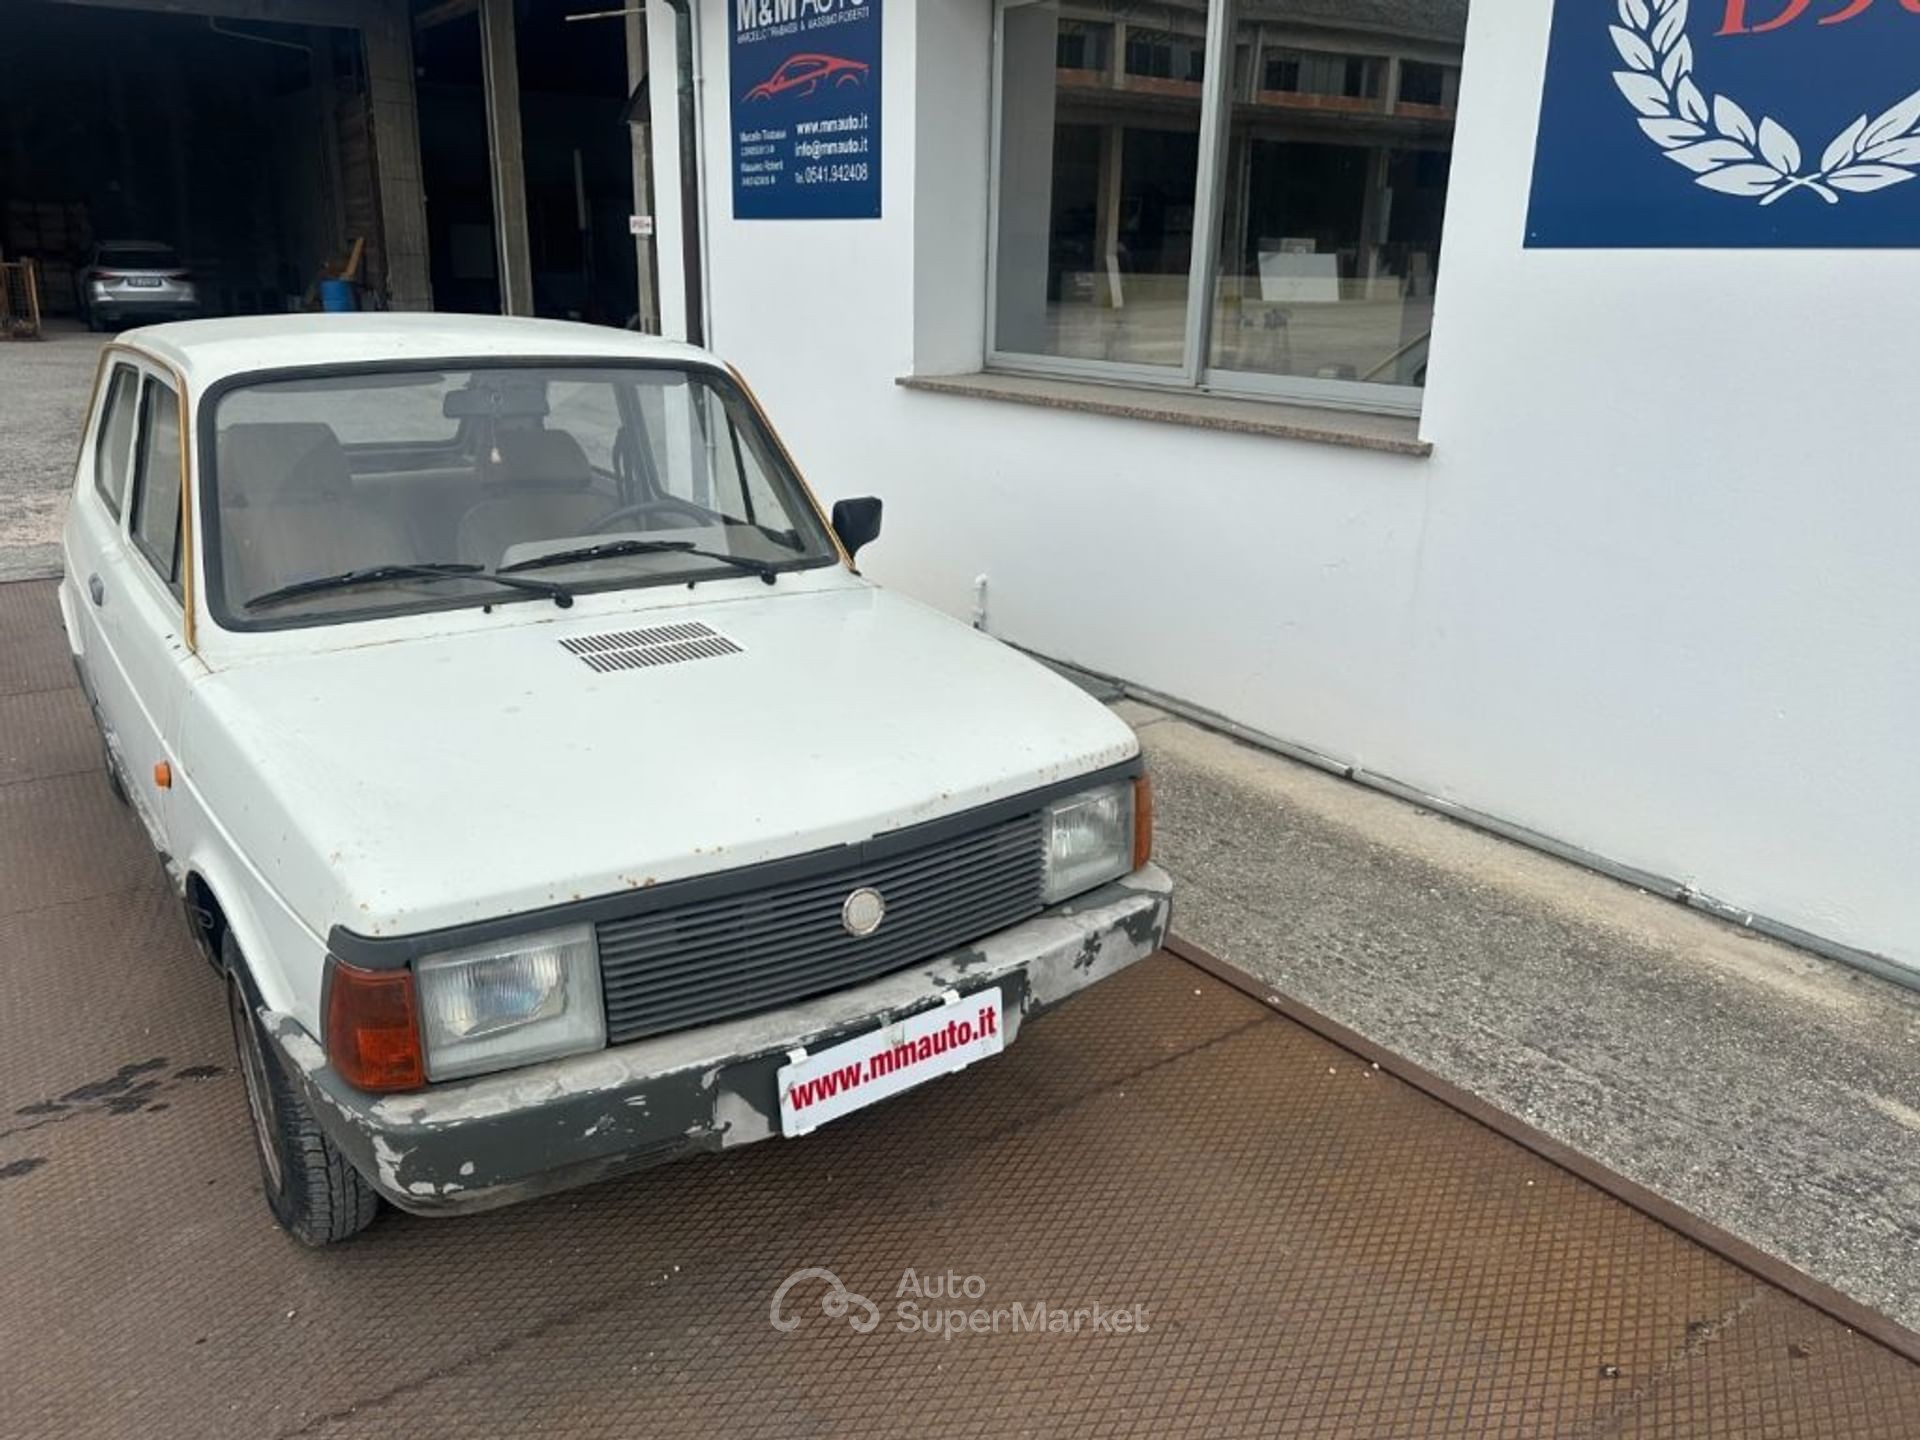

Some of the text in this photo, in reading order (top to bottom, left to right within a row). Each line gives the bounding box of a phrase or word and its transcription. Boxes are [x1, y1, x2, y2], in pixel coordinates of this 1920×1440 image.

[796, 113, 868, 135] www.mmauto.it
[795, 136, 868, 159] info@mmauto.it
[790, 1006, 997, 1111] www.mmauto.it
